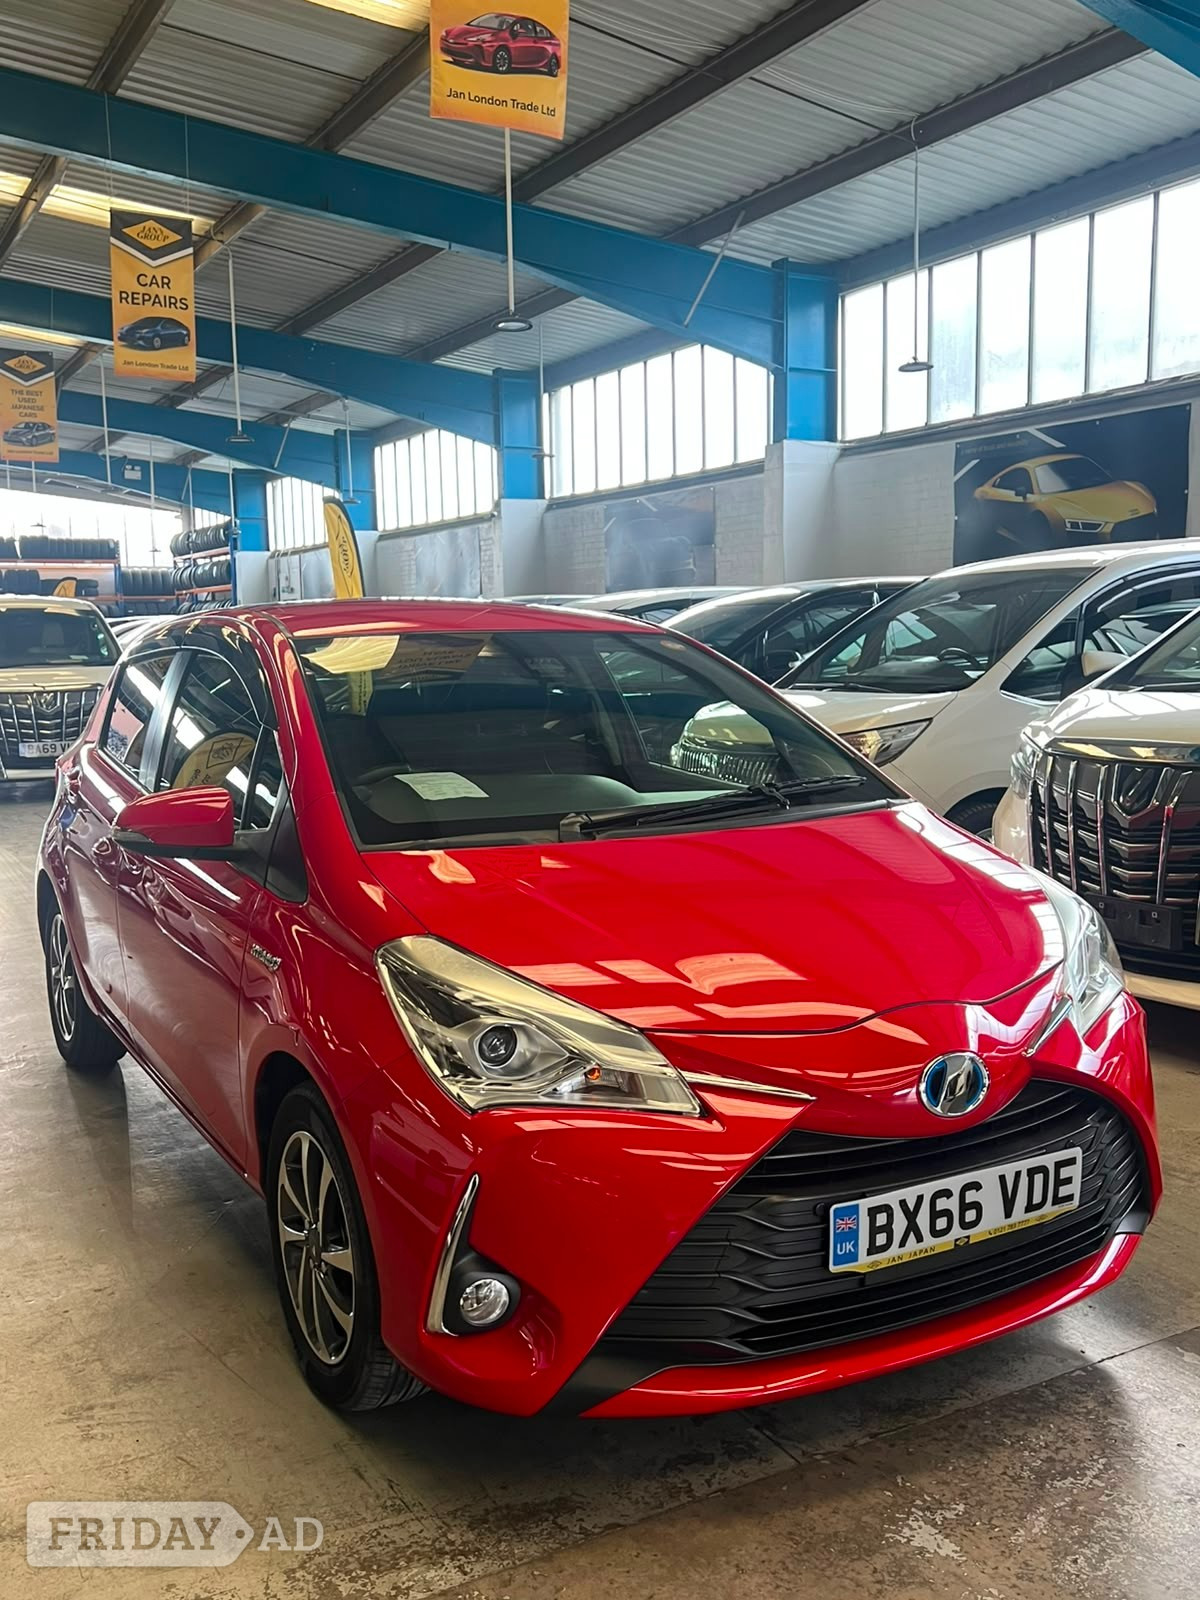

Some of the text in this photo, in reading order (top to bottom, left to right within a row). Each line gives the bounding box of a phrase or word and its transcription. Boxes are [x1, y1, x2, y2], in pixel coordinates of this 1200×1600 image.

[446, 87, 556, 117] Jan London Trade Ltd
[136, 231, 170, 243] GROUP
[136, 273, 171, 289] CAR
[119, 290, 189, 311] REPAIRS
[865, 1156, 1078, 1257] BX66 VDE
[836, 1239, 856, 1256] UK
[886, 1254, 904, 1265] JAN
[908, 1245, 936, 1258] JAPAN
